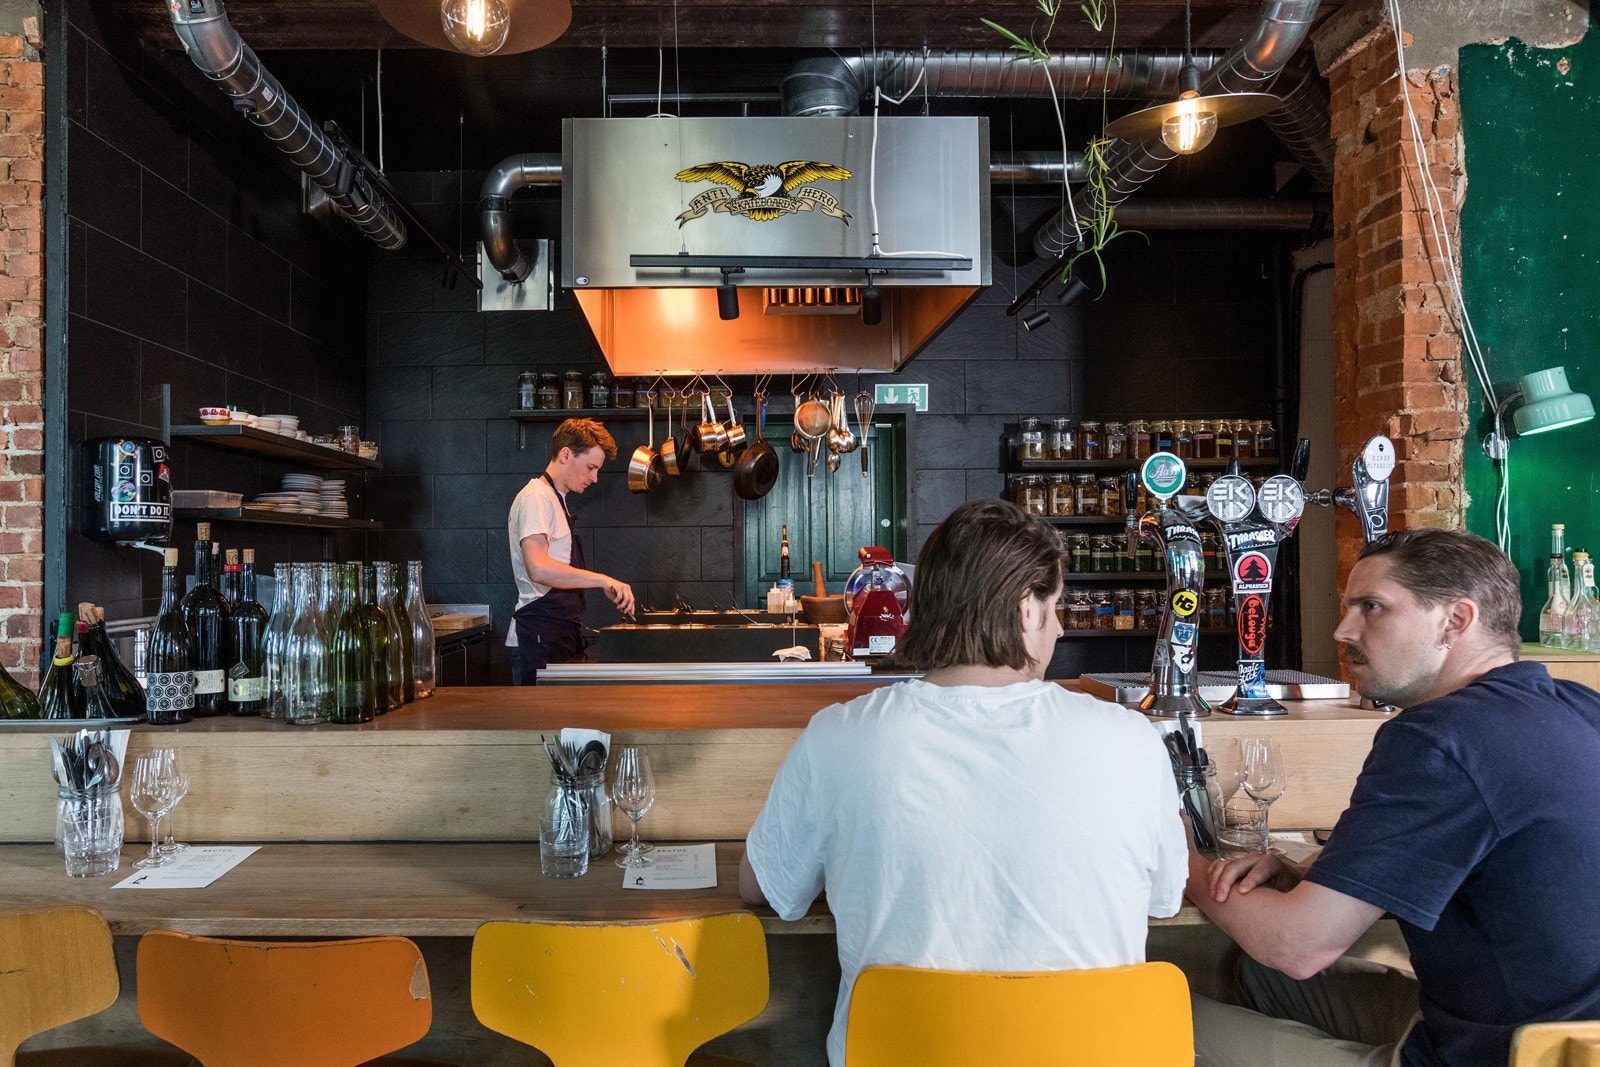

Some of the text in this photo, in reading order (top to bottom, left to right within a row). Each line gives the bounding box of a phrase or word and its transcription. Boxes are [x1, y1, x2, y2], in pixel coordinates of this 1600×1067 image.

[694, 188, 834, 209] ANTI HERO
[731, 197, 797, 211] SKATEBOARDS
[114, 504, 147, 515] DON'T
[150, 506, 162, 515] DO
[1228, 528, 1277, 549] THRASHER
[1175, 594, 1194, 611] HG
